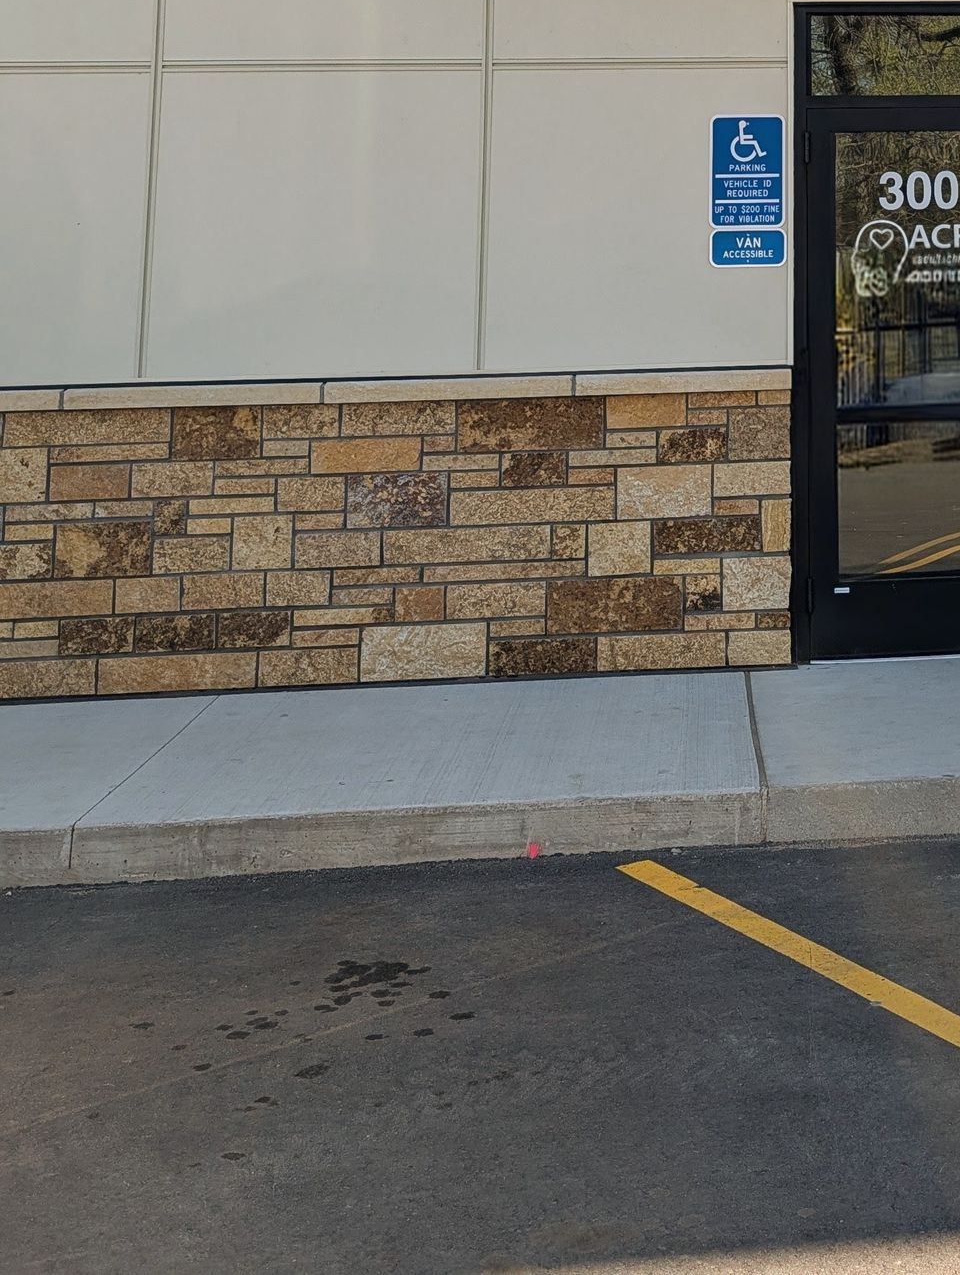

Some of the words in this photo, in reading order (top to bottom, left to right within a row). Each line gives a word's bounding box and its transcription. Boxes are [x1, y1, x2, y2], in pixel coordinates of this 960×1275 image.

[728, 164, 767, 172] PARKING
[723, 180, 758, 188] VEHICLE
[763, 180, 772, 188] ID
[726, 189, 769, 198] REQUIRED
[878, 170, 959, 211] 300
[714, 206, 724, 214] UP
[728, 205, 737, 214] TO
[741, 205, 760, 214] $200
[763, 205, 780, 213] FINE
[720, 215, 735, 223] FOR
[738, 214, 775, 223] VIOLATION
[736, 237, 761, 248] VAN
[723, 249, 774, 258] ACCESSIBLE
